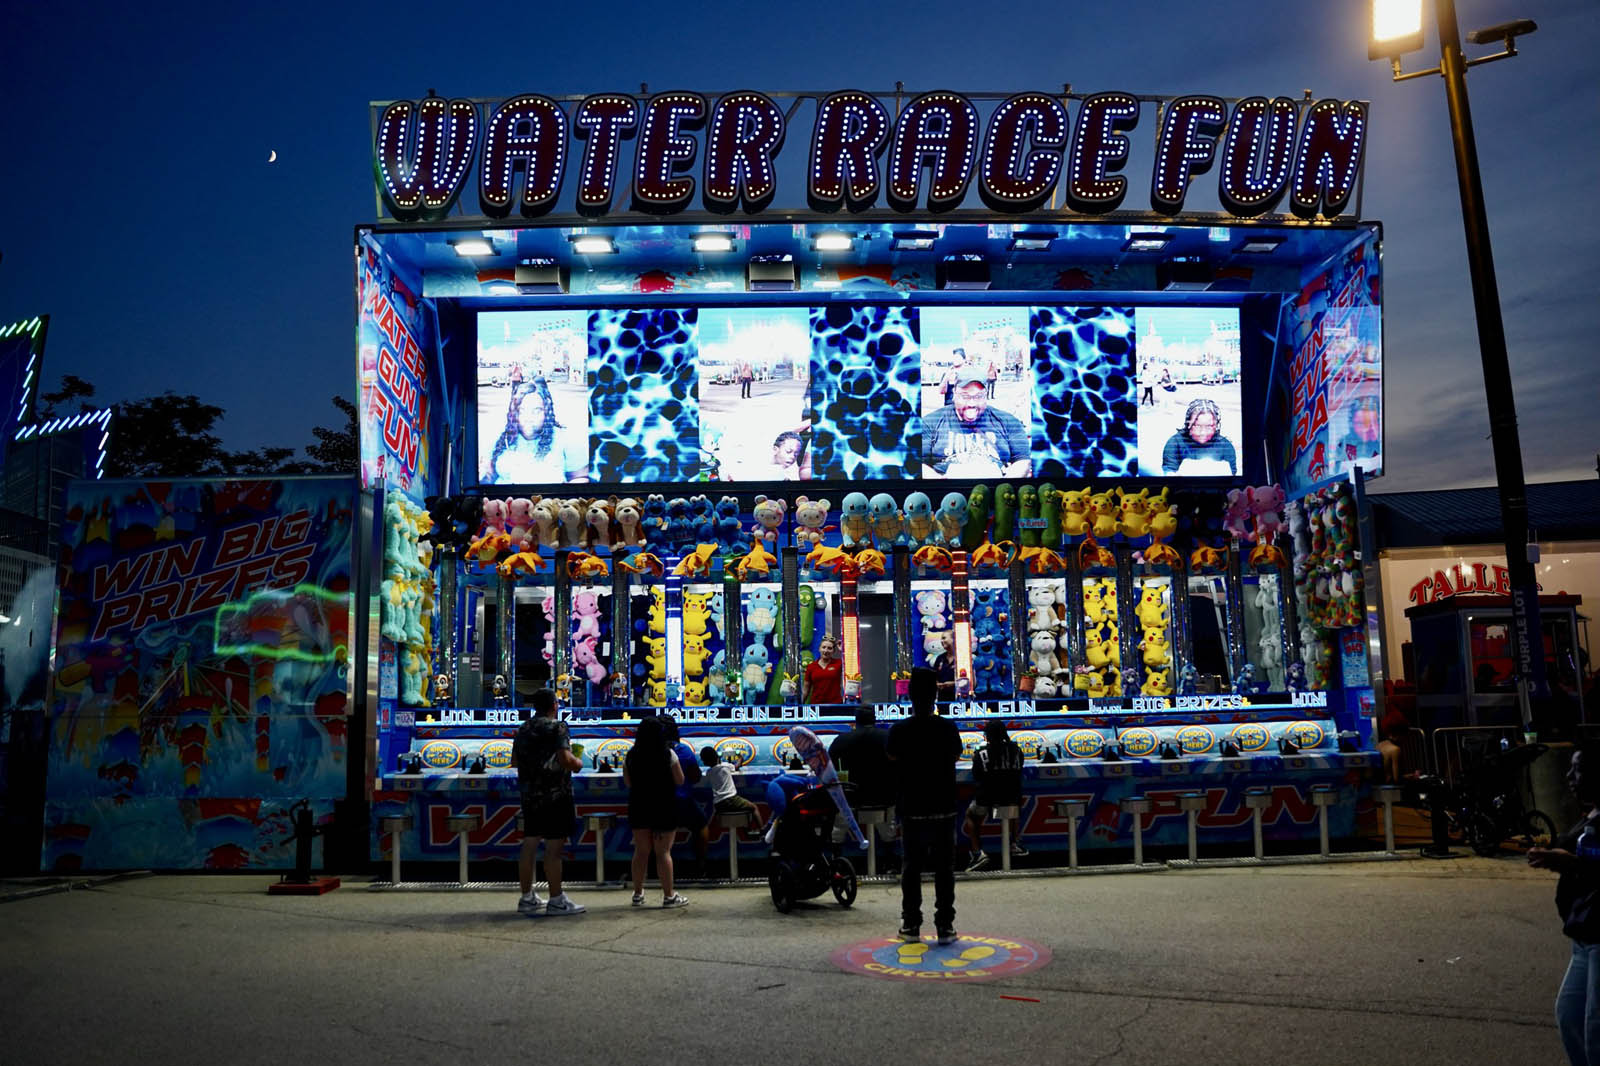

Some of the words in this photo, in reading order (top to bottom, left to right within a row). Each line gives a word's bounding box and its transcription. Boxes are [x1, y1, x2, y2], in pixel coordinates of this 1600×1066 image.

[375, 90, 787, 220] WATER
[807, 89, 1140, 217] RACE
[1151, 96, 1365, 219] FUN
[365, 268, 428, 390] WATER
[377, 346, 417, 417] GUN
[368, 384, 419, 473] FUN
[92, 537, 205, 601] WIN
[213, 509, 316, 569] BIG
[91, 543, 317, 642] PRIZES
[1410, 563, 1543, 606] TALLE
[1514, 590, 1526, 616] LOT
[1516, 617, 1532, 673] PURPLE
[440, 709, 475, 726] WIN
[485, 709, 520, 725] BIG
[731, 706, 769, 721] GUN
[781, 705, 820, 720] FUN
[949, 701, 989, 717] GUN
[998, 700, 1037, 716] FUN
[1132, 697, 1165, 713] BIG
[1175, 694, 1243, 711] PRIZES
[864, 962, 993, 978] CIRCLE
